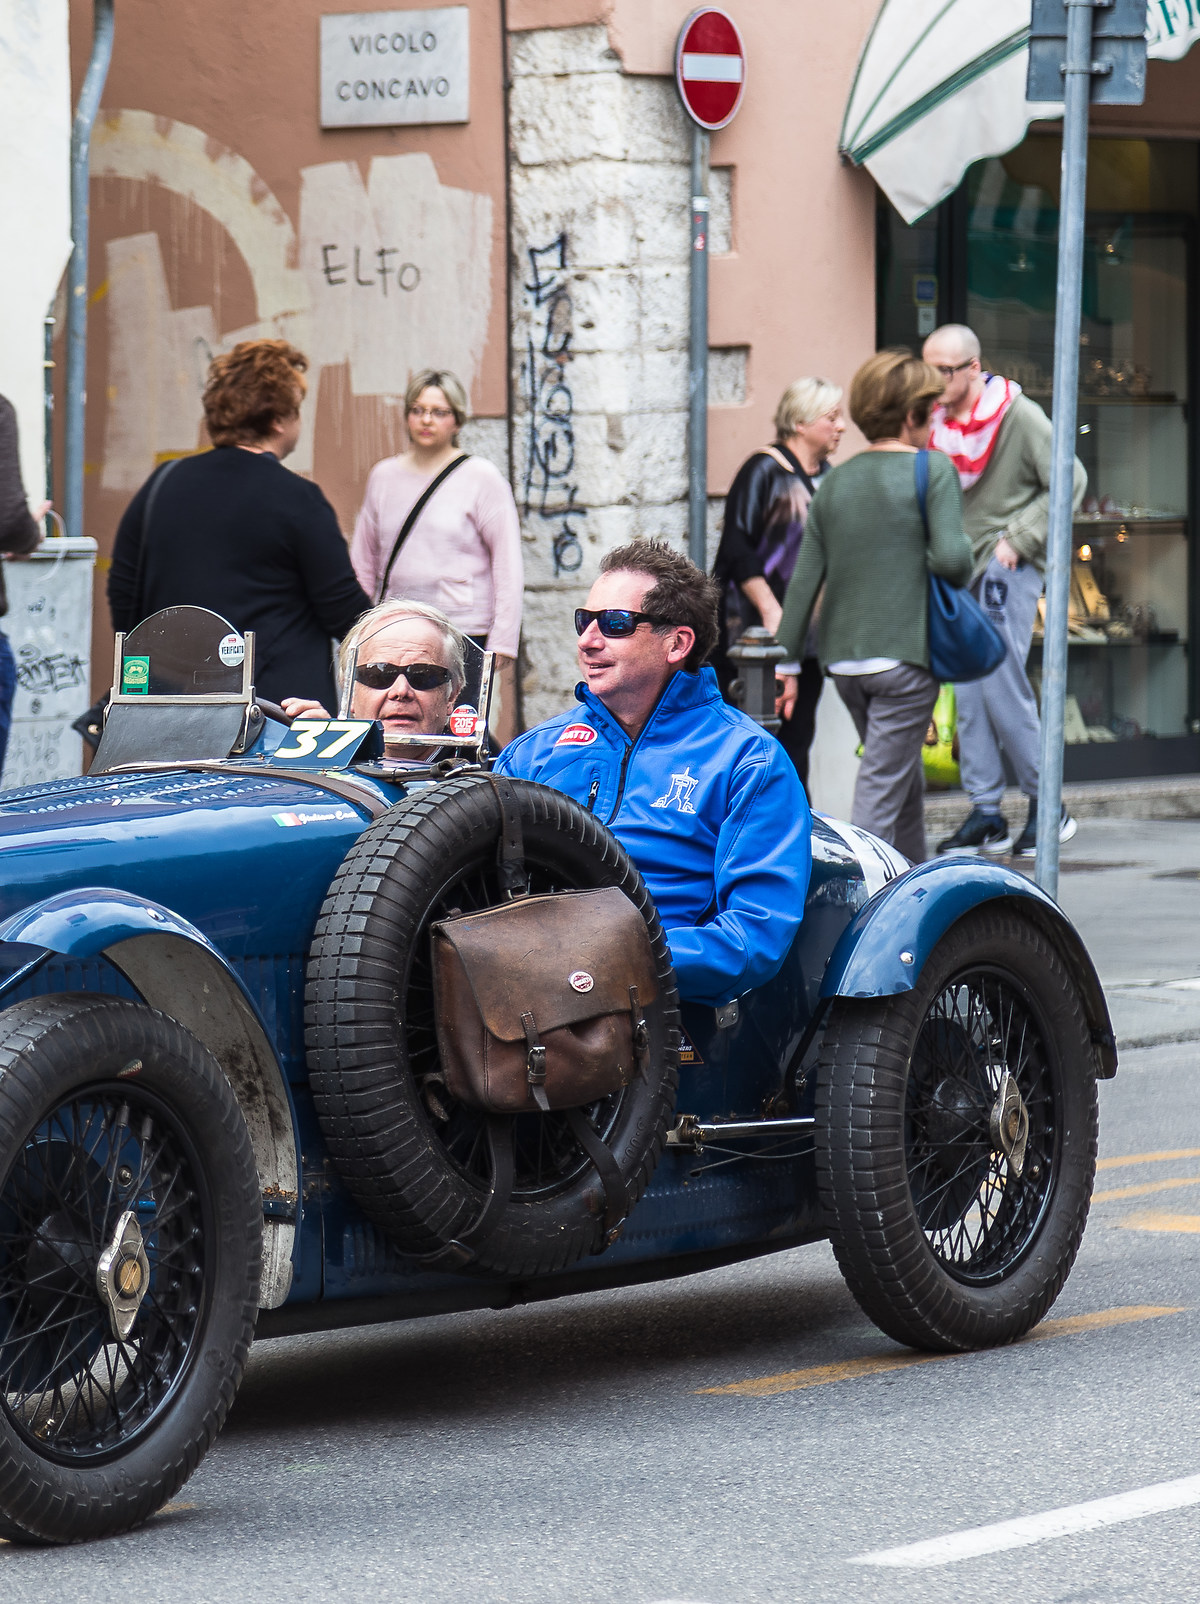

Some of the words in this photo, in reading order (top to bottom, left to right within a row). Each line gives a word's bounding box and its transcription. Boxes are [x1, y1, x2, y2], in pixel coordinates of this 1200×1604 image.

[349, 30, 437, 55] VICOLO
[335, 75, 450, 102] CONCAVO
[453, 717, 474, 728] 2015
[273, 720, 371, 759] 37
